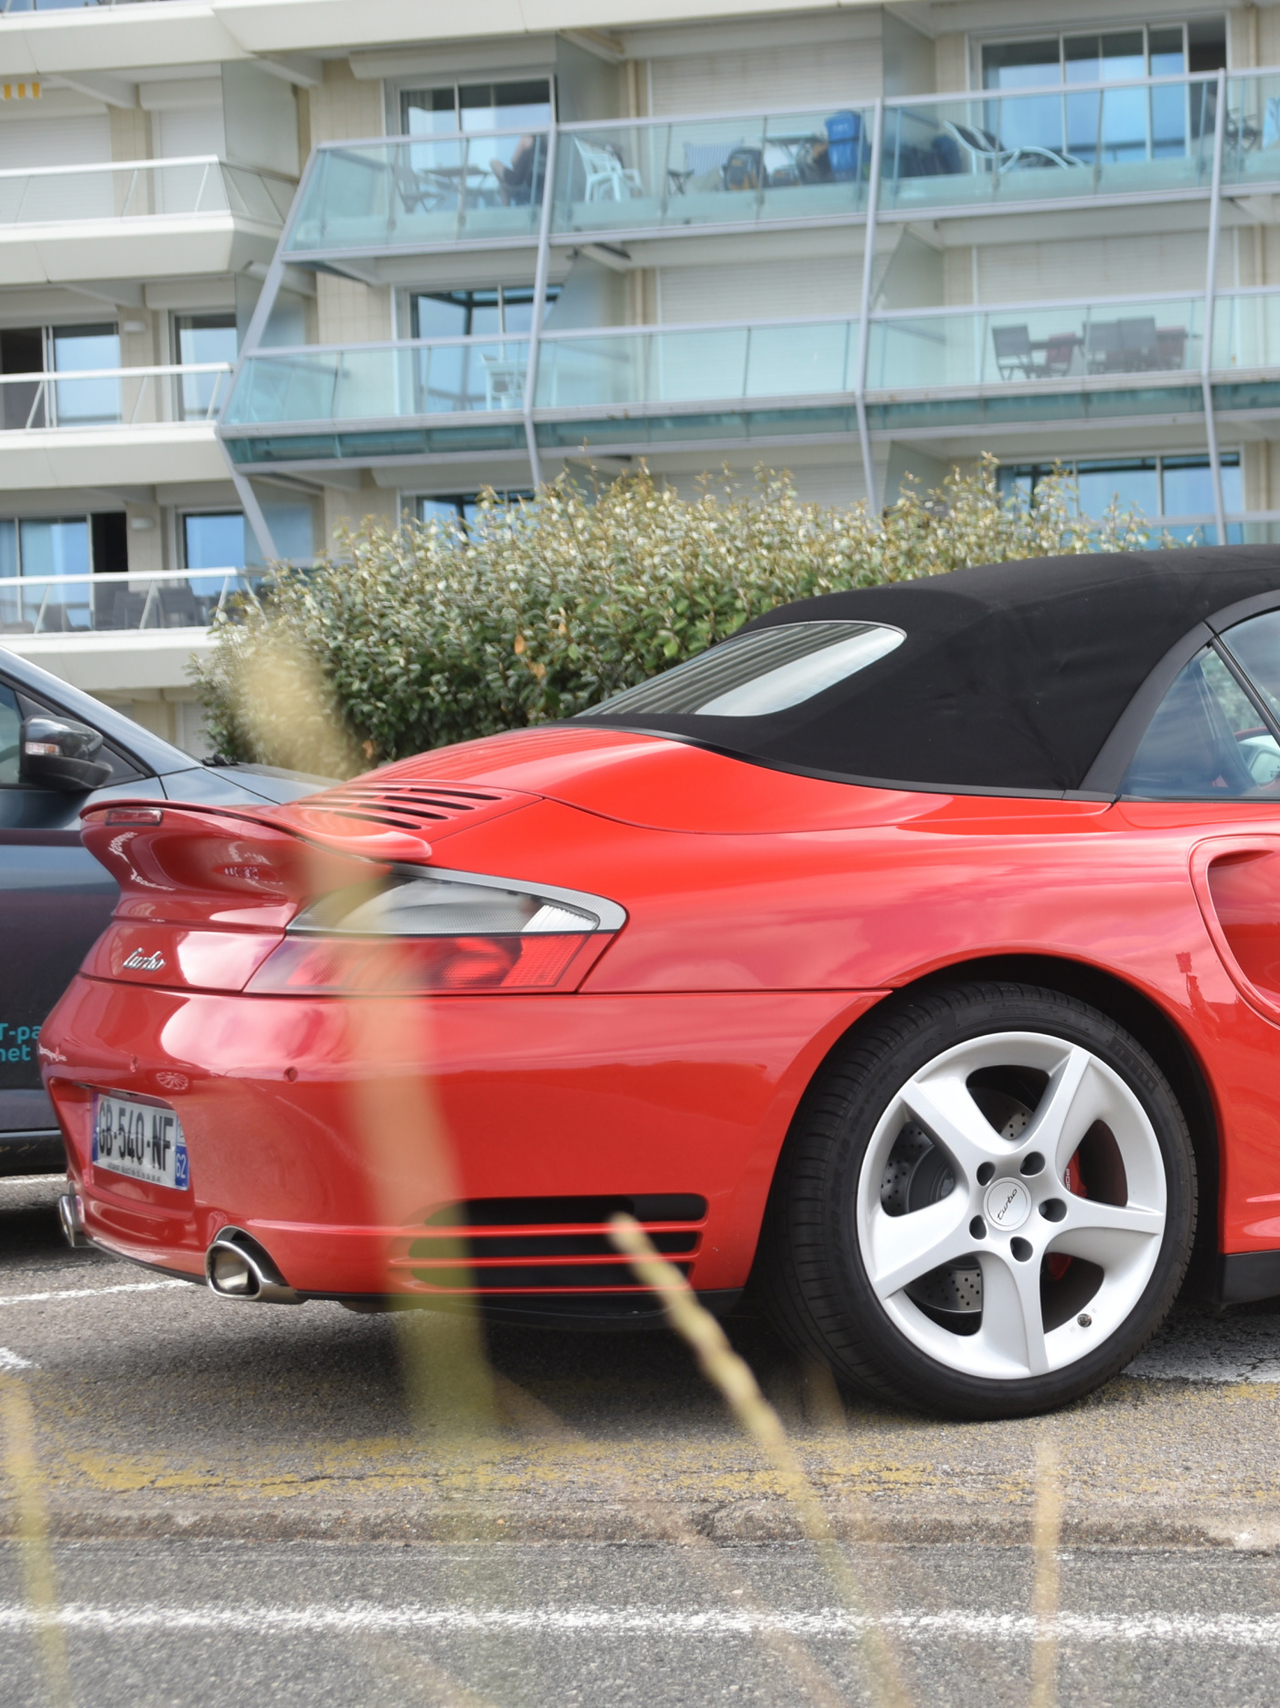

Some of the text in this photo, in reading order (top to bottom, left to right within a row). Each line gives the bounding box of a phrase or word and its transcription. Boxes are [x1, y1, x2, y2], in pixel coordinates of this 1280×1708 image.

[123, 947, 166, 971] turbo
[176, 1153, 187, 1178] 62
[997, 1188, 1017, 1221] turbo
